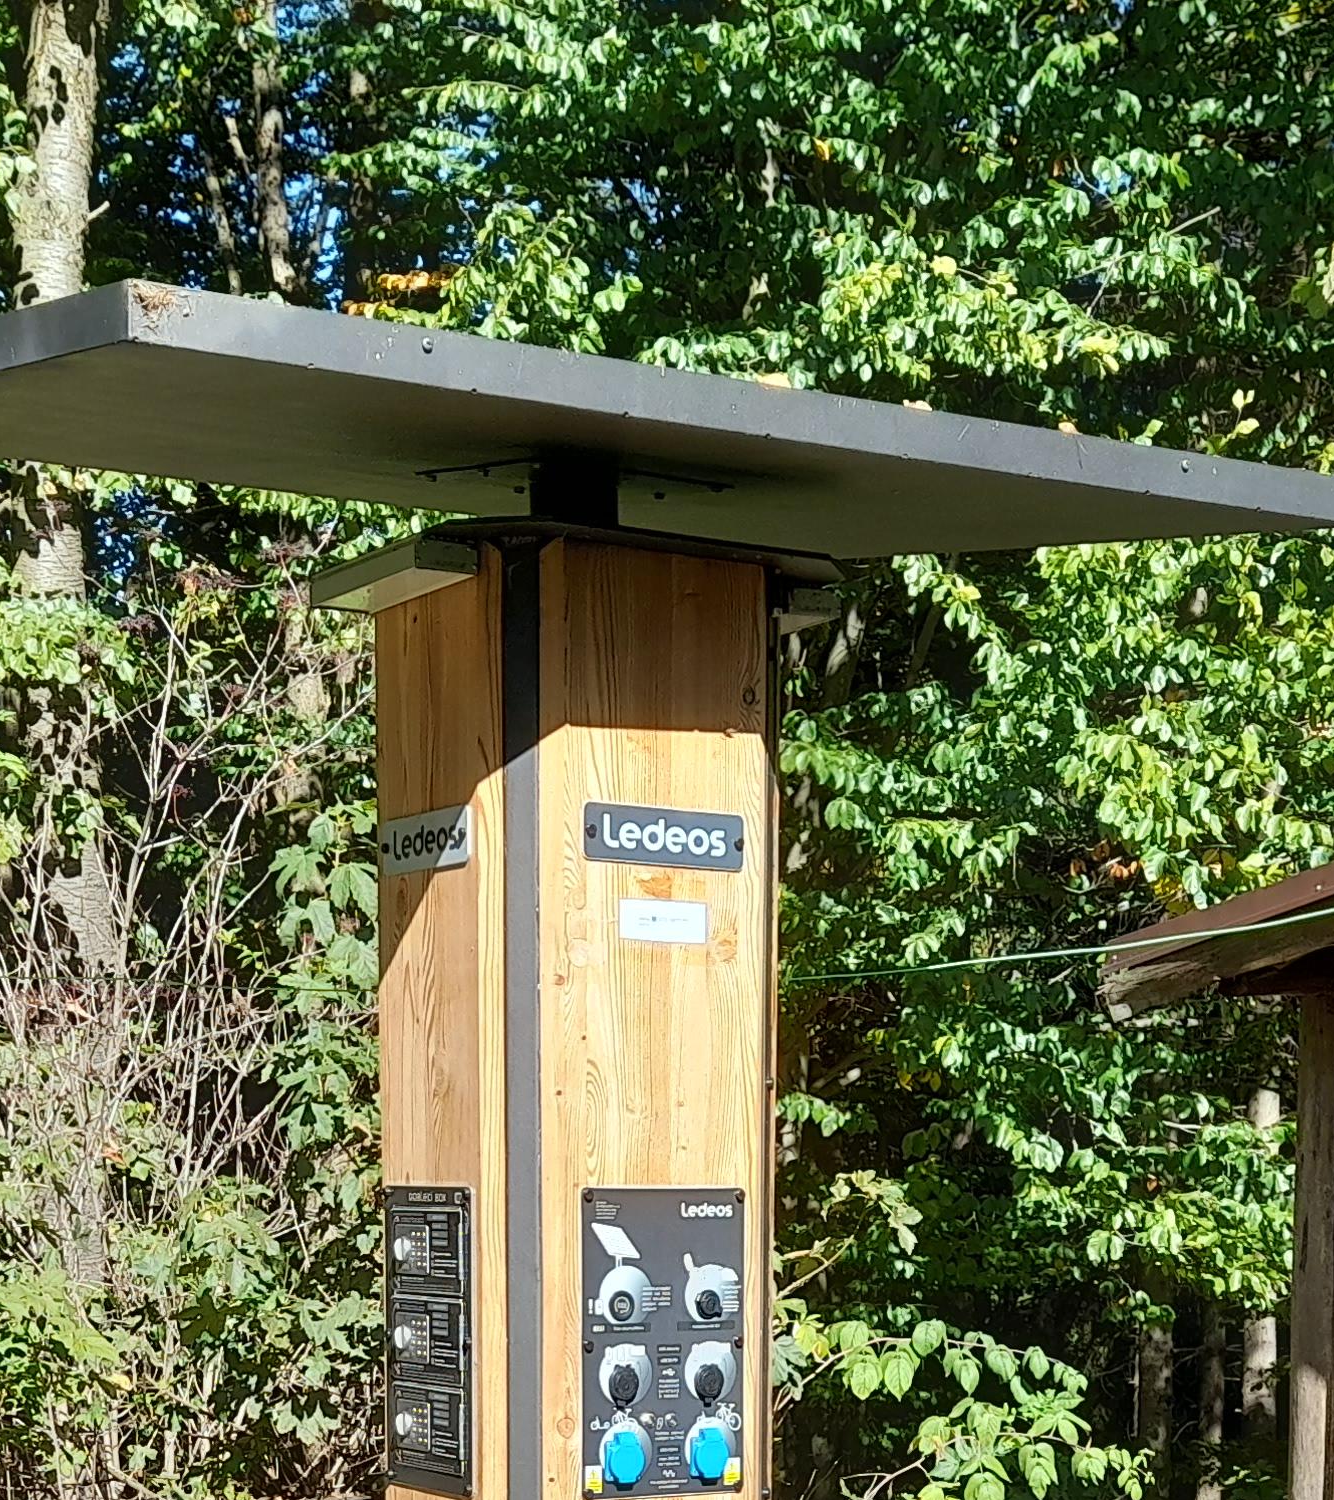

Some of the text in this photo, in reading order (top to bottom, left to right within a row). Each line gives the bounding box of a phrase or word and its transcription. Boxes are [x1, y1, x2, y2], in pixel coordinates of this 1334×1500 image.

[393, 824, 457, 861] Ledeos
[603, 812, 727, 857] Ledeos
[680, 1202, 733, 1218] Ledeos
